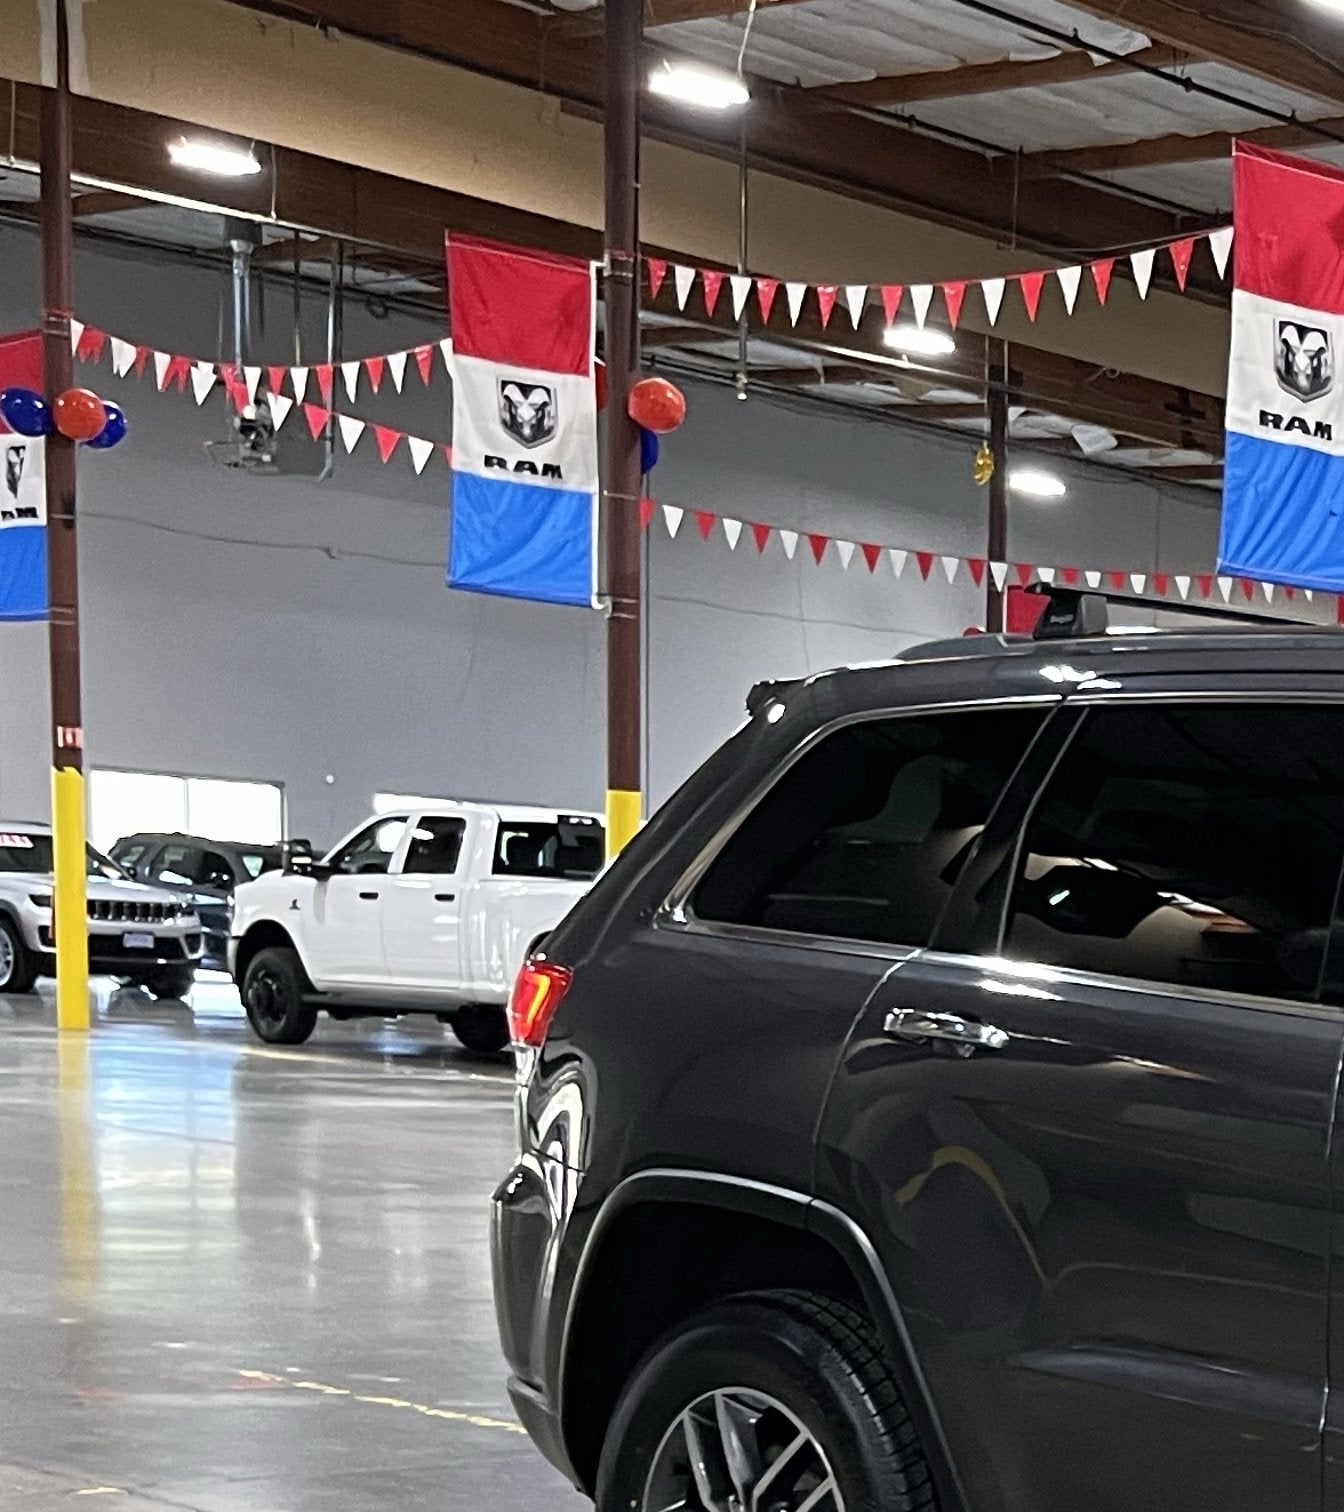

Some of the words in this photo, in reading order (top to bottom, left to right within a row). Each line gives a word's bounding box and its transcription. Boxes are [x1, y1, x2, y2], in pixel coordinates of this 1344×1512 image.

[1259, 409, 1333, 440] RAM
[484, 454, 563, 479] RAM
[0, 506, 38, 520] AM
